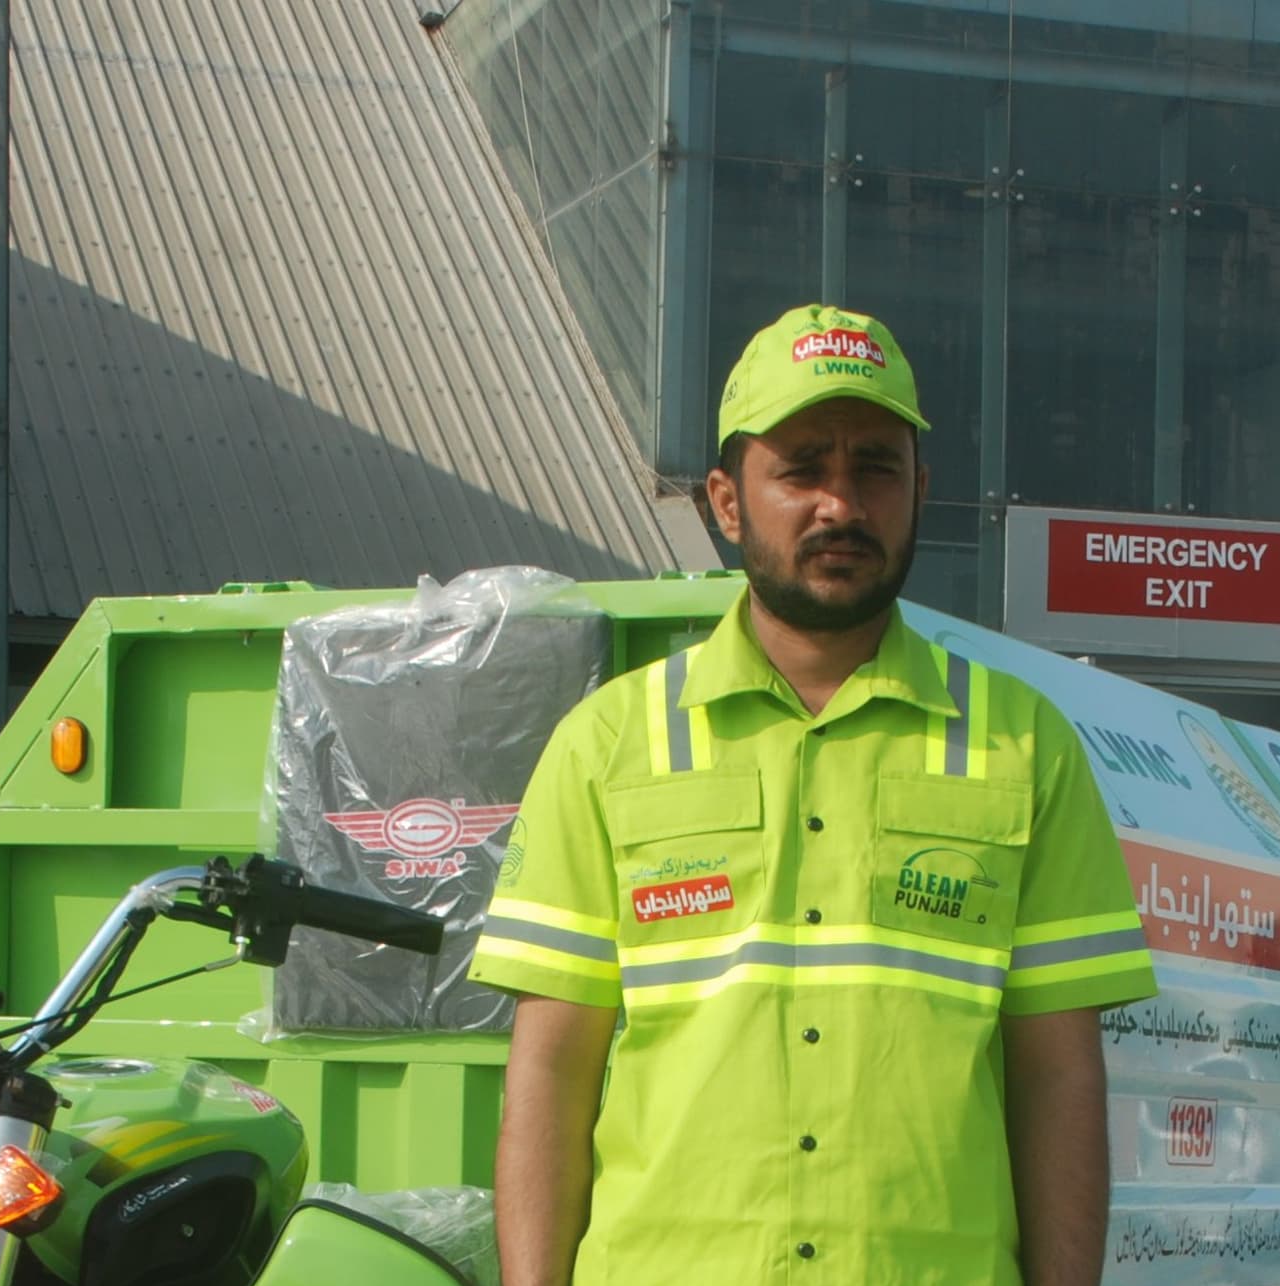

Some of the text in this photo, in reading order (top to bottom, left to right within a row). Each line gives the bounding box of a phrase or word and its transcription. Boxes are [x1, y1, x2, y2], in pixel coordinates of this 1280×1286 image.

[814, 361, 874, 379] LWMC
[1085, 532, 1269, 573] EMERGENCY
[1145, 577, 1214, 609] EXIT
[1075, 722, 1193, 791] LWMC
[385, 857, 461, 879] SIWA
[898, 867, 969, 901] CLEAN
[635, 889, 682, 920] پنجاب
[894, 889, 962, 919] PUNJAB
